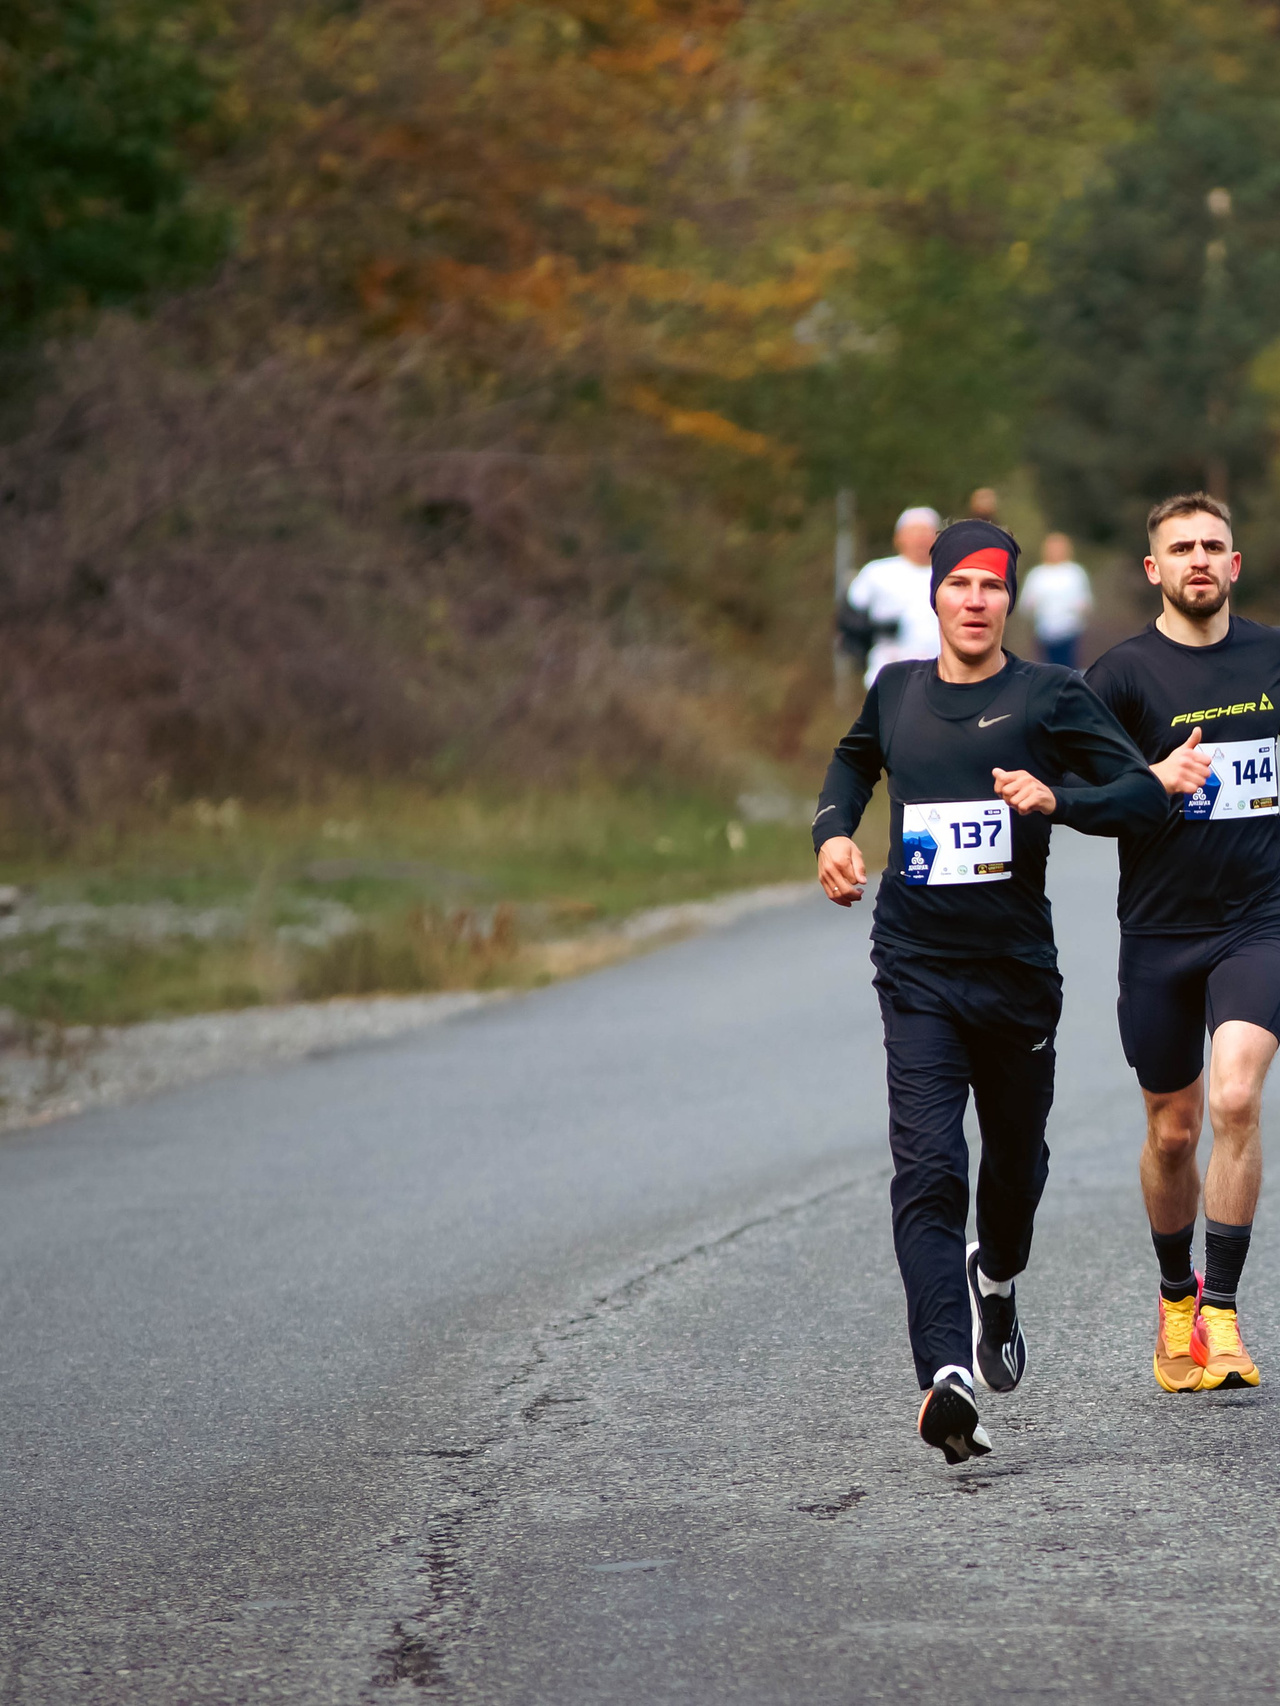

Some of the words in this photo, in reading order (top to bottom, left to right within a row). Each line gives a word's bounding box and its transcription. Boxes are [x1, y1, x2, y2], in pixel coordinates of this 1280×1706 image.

[1171, 702, 1257, 727] FISCHER
[1232, 757, 1273, 785] 144
[949, 820, 1002, 849] 137
